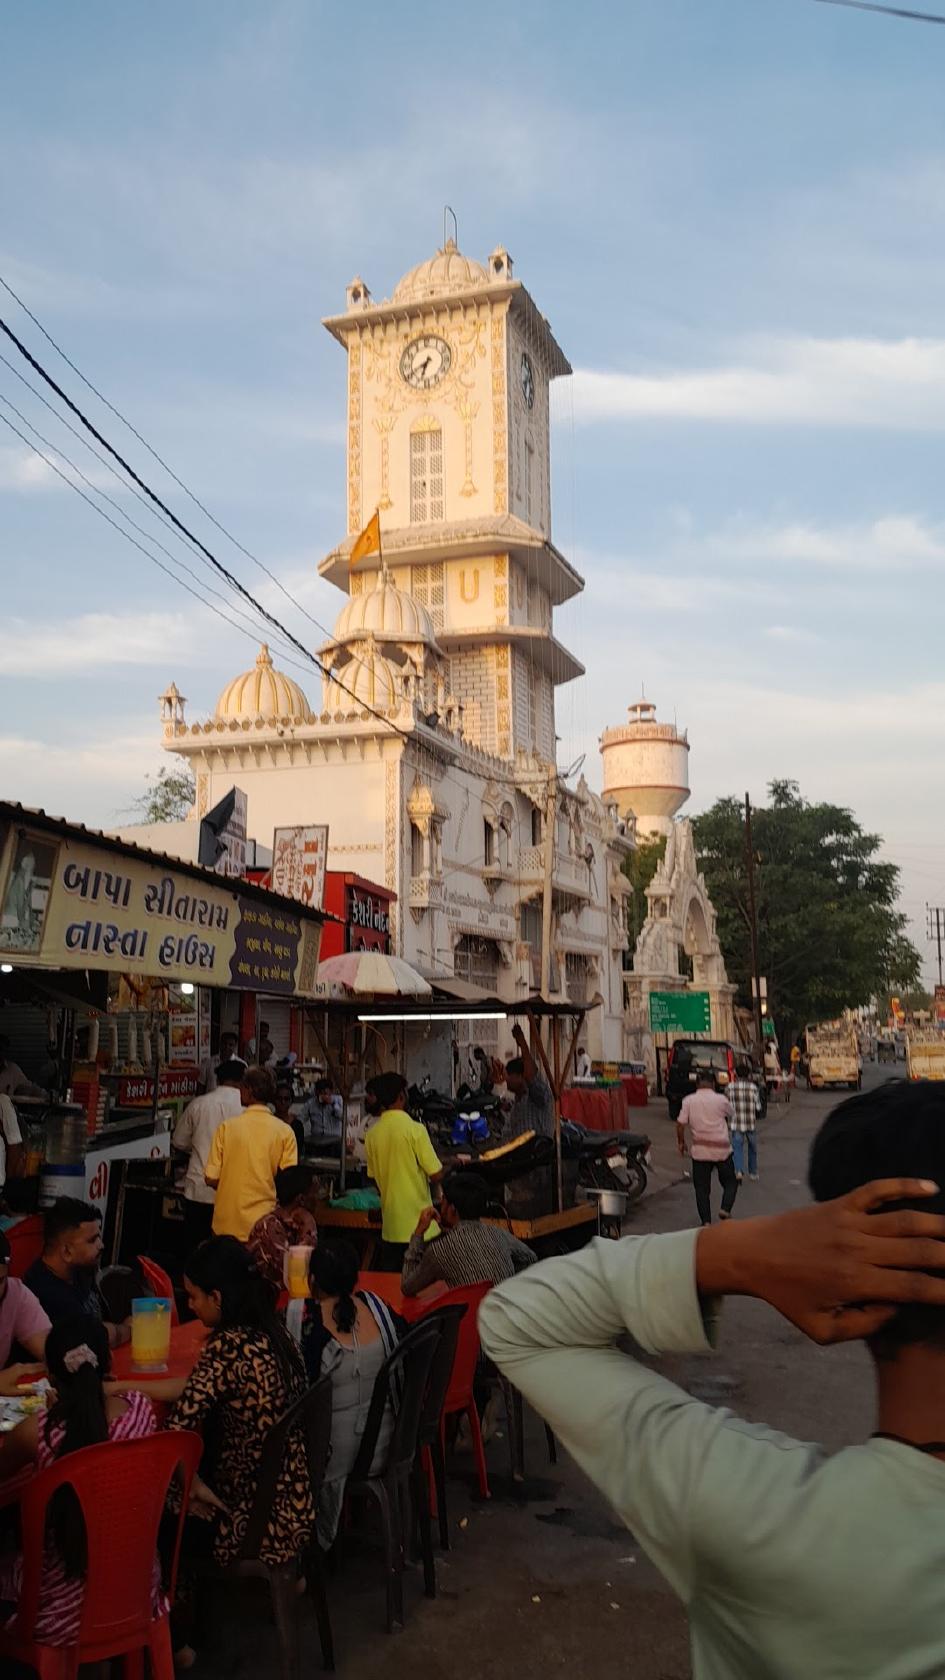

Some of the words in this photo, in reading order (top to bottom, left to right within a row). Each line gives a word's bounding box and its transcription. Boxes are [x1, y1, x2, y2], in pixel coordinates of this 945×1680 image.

[63, 863, 132, 907] બાપા
[145, 877, 229, 930] સીતારામ
[352, 887, 373, 928] કેશરી
[65, 920, 148, 958] નાસ્તા
[158, 934, 216, 969] હાઉસ
